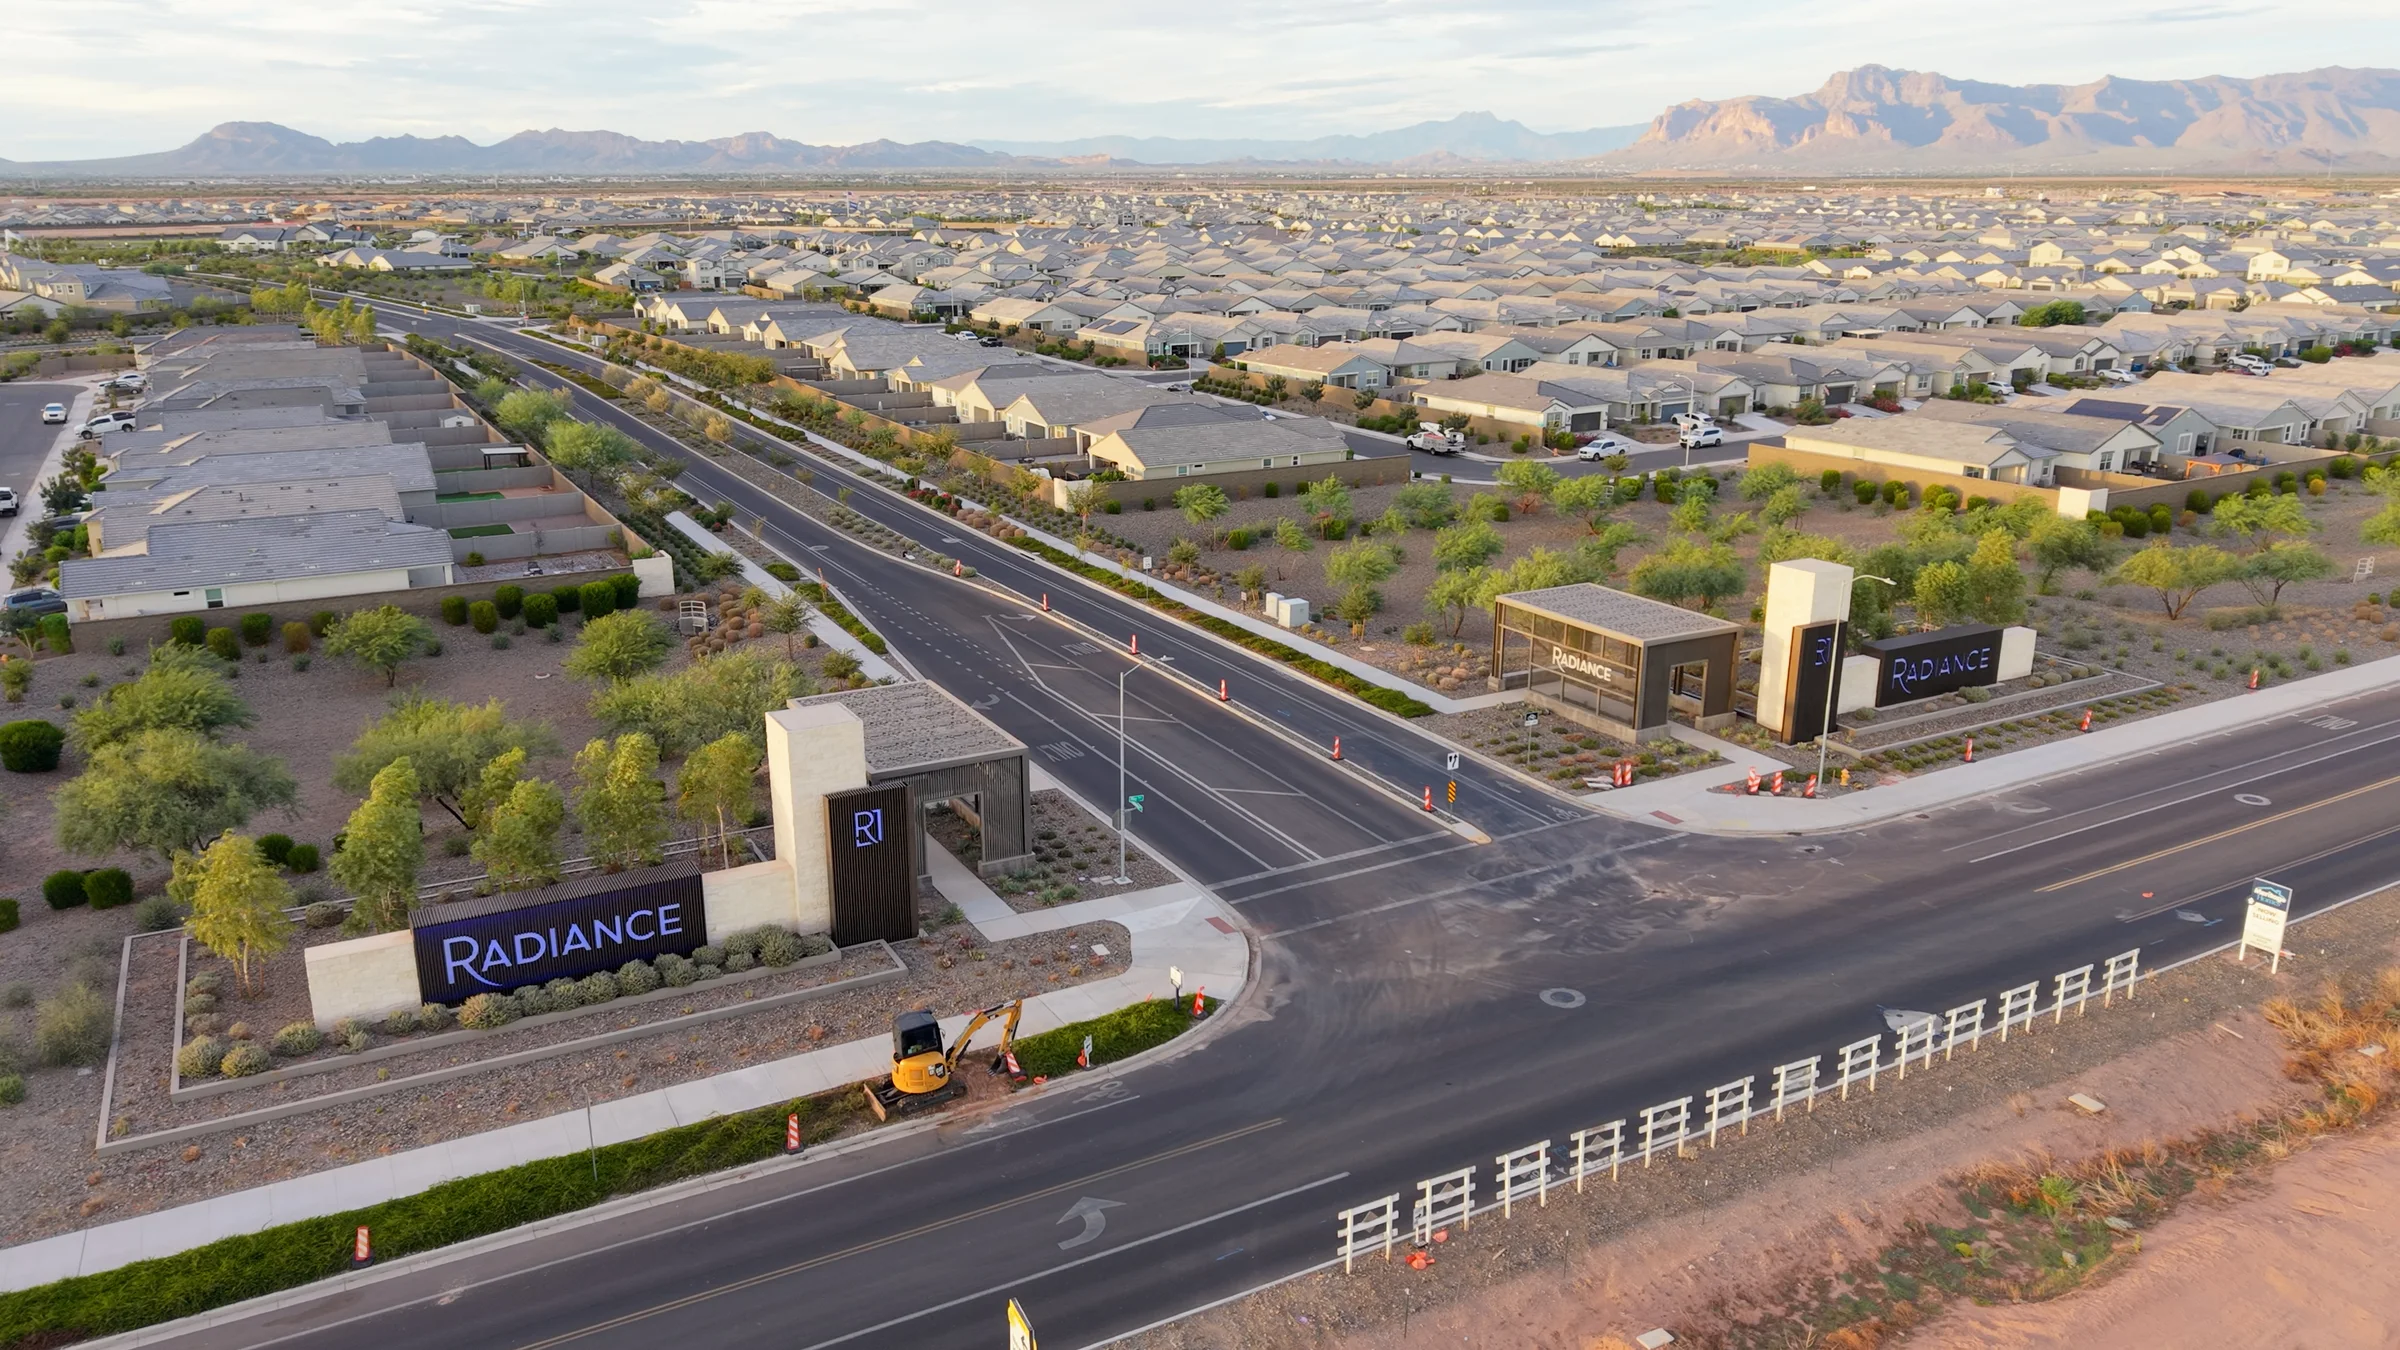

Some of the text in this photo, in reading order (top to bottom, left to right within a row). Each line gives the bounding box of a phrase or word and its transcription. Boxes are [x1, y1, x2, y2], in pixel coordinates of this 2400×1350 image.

[1060, 641, 1102, 656] ONLY
[1552, 645, 1612, 682] RADIANCE
[1892, 647, 1991, 694] RADIANCE
[2298, 713, 2359, 730] ONLY
[1035, 741, 1085, 763] ONLY
[2252, 912, 2280, 926] SELLING
[2257, 907, 2277, 917] NOW
[443, 902, 683, 987] RADIANCE
